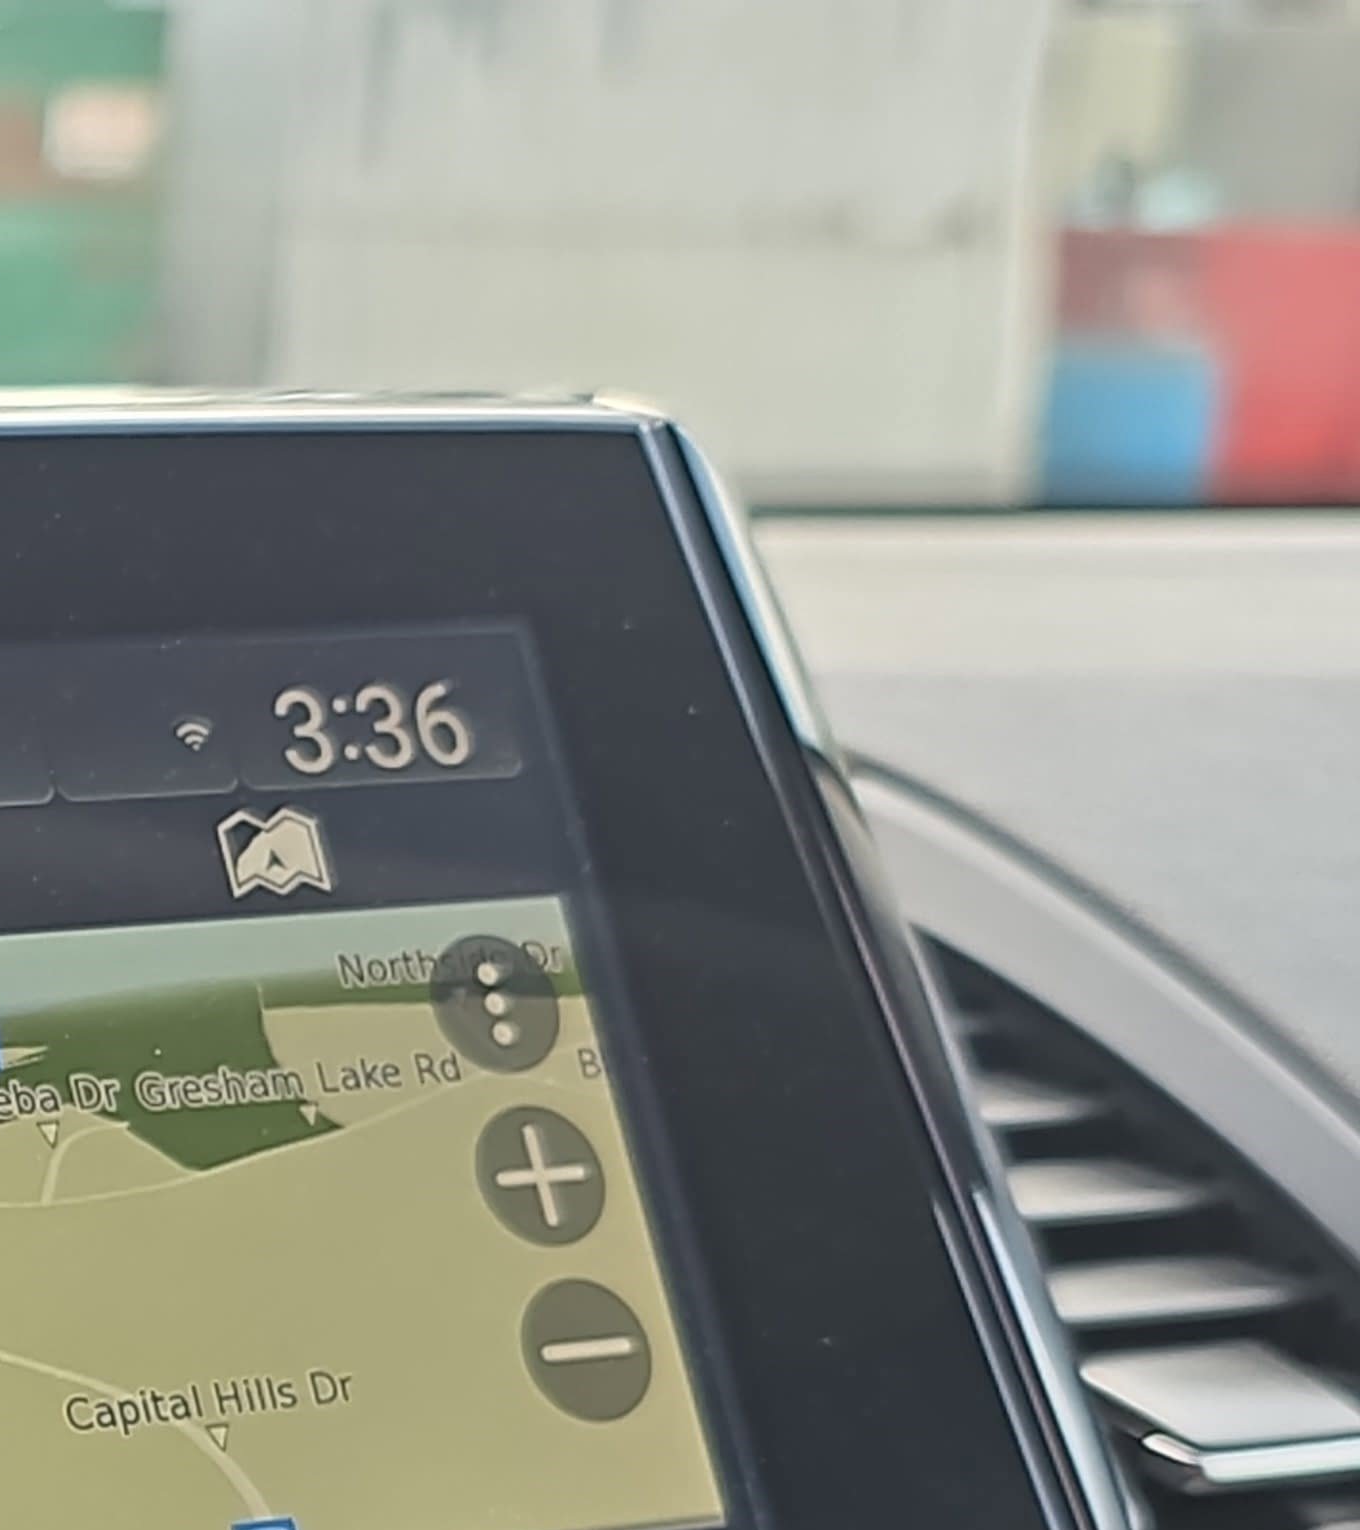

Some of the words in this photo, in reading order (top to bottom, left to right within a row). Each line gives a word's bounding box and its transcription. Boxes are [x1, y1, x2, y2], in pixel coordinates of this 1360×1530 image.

[273, 681, 471, 776] 3:36
[69, 1075, 120, 1110] Dr
[134, 1066, 305, 1108] Gresham
[315, 1055, 403, 1096] Lake
[414, 1050, 462, 1086] Rd
[64, 1384, 204, 1437] Capital
[213, 1377, 299, 1416] Hills
[309, 1370, 354, 1405] Dr
